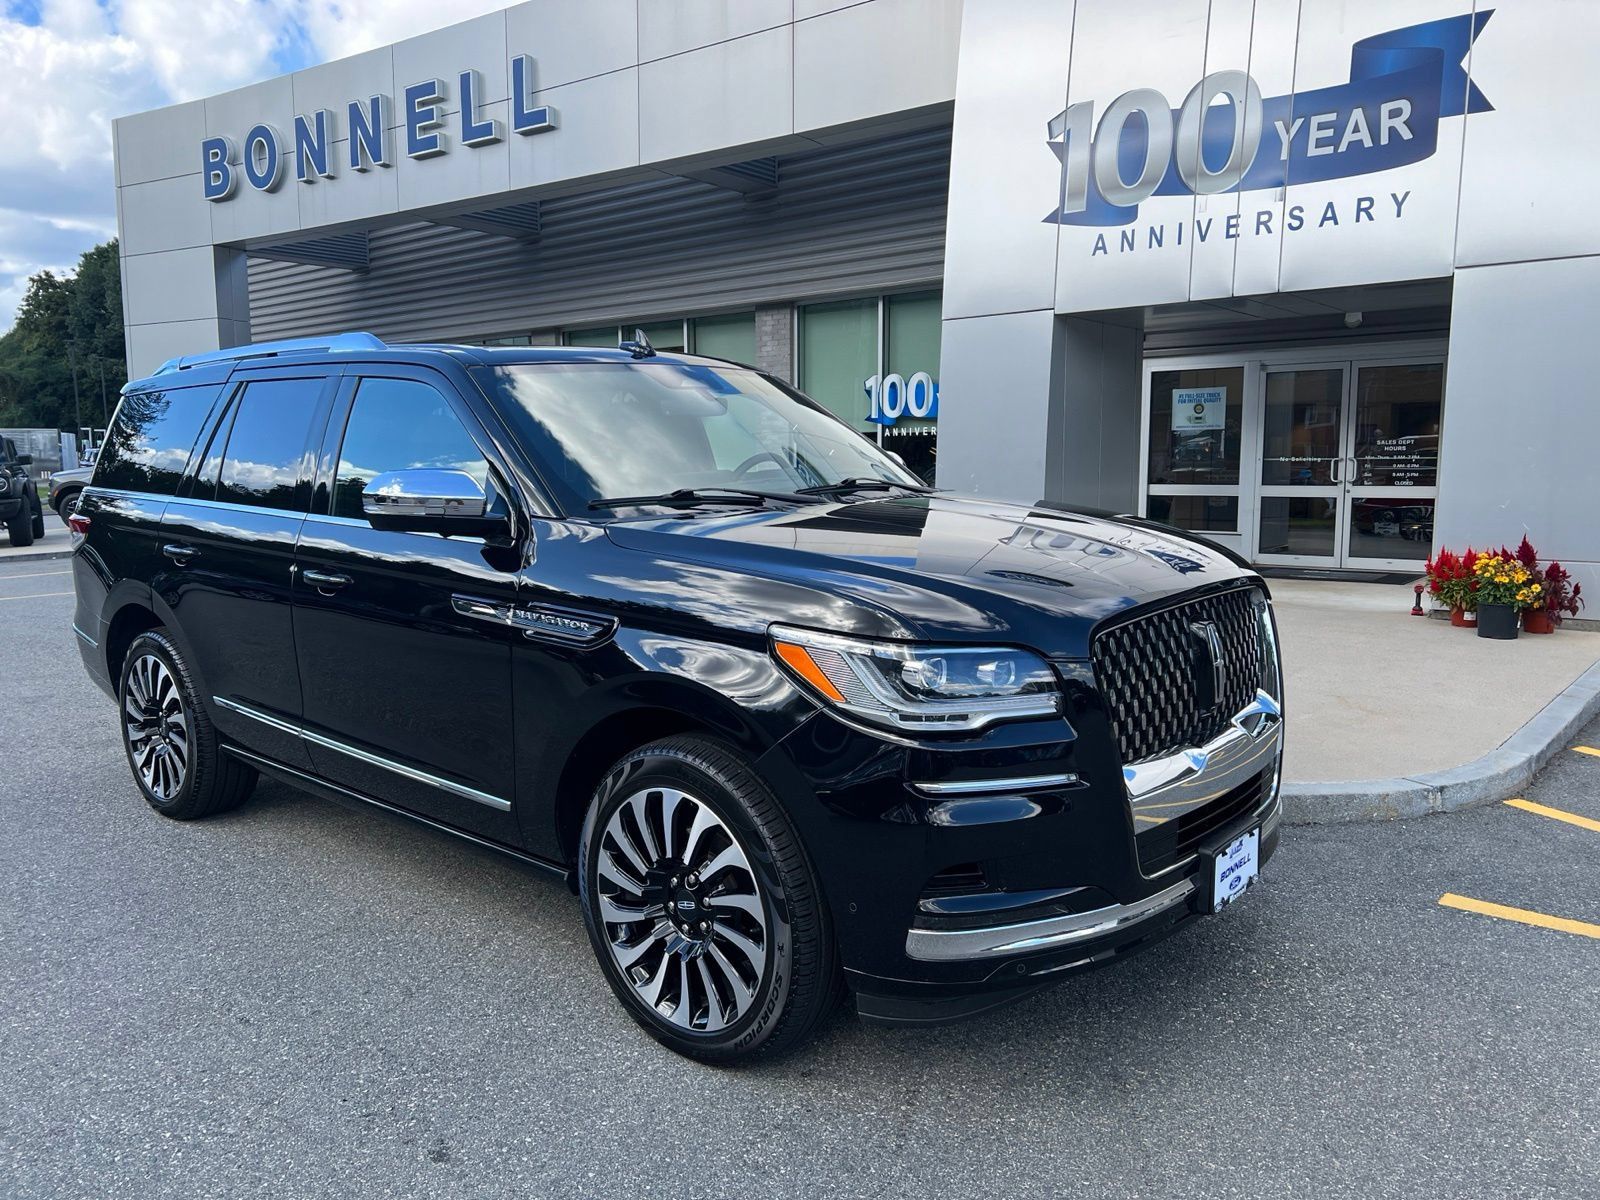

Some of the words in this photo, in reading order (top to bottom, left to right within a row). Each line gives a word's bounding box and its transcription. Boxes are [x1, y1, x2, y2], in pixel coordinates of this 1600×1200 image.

[201, 53, 557, 202] BONNELL
[1047, 69, 1263, 214] 100
[1274, 98, 1414, 161] YEAR
[1091, 190, 1412, 257] ANNIVERSARY
[864, 371, 934, 419] 100
[515, 609, 590, 632] NAVIGATOR
[1220, 853, 1251, 883] BONNELL
[734, 971, 783, 1049] SCORPION
